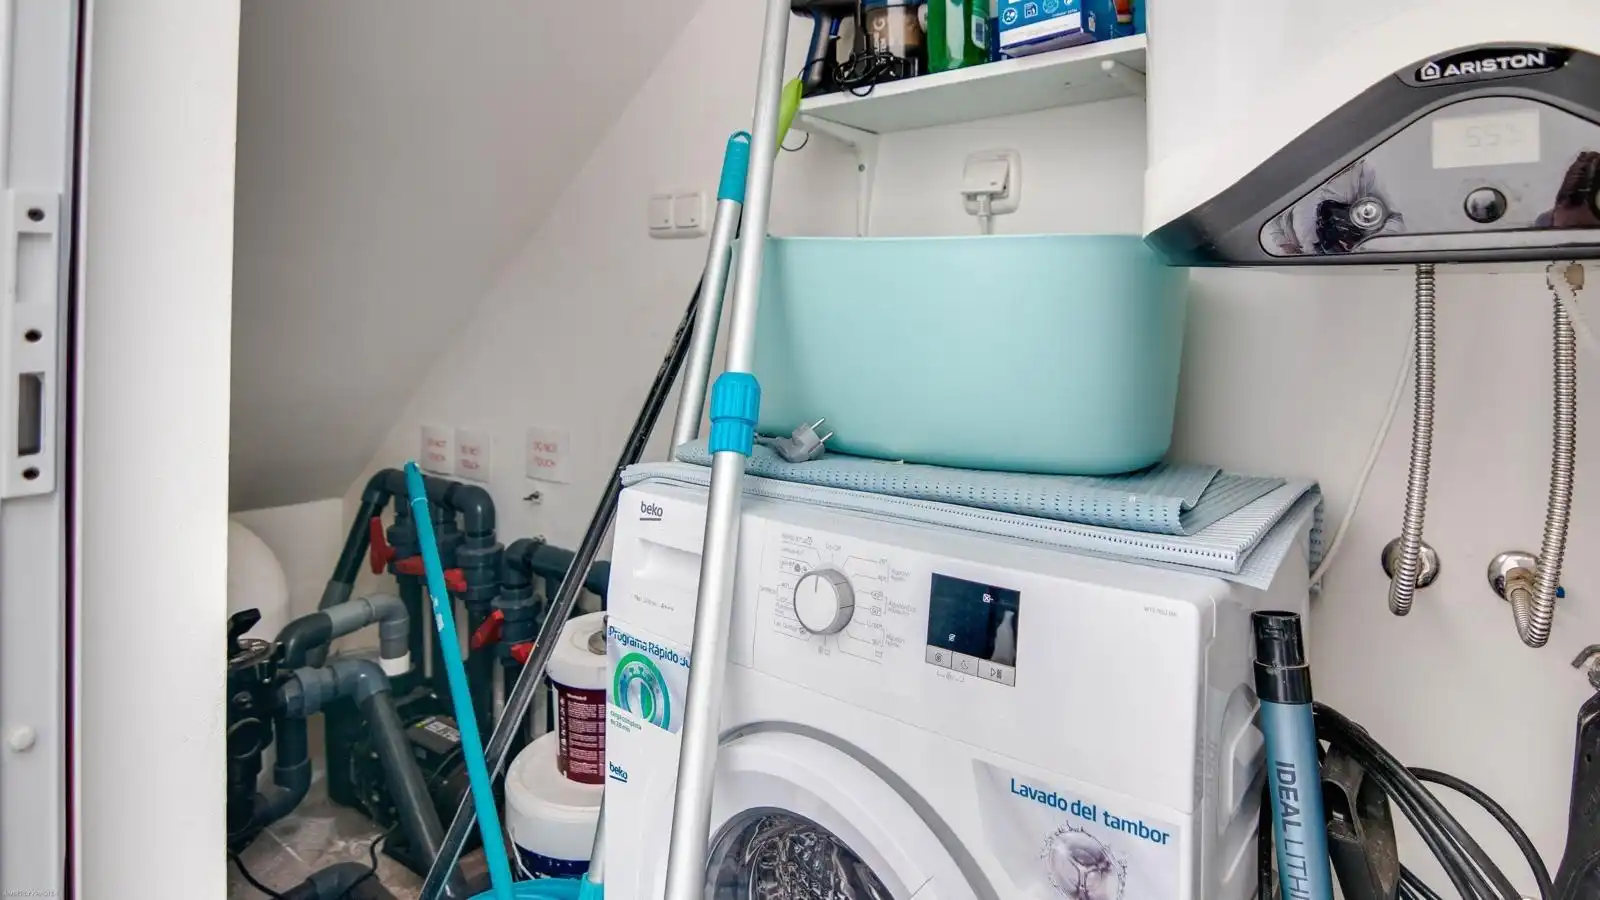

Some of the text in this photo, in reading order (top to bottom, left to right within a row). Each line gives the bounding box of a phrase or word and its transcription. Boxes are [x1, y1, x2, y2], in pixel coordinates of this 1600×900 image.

[1443, 52, 1546, 77] ARISTON
[640, 500, 664, 518] beko
[609, 625, 648, 652] Programa
[648, 640, 679, 663] Rápido
[609, 761, 628, 780] beko
[1010, 778, 1170, 845] Lavado del tambor
[1275, 760, 1302, 833] IDEAL
